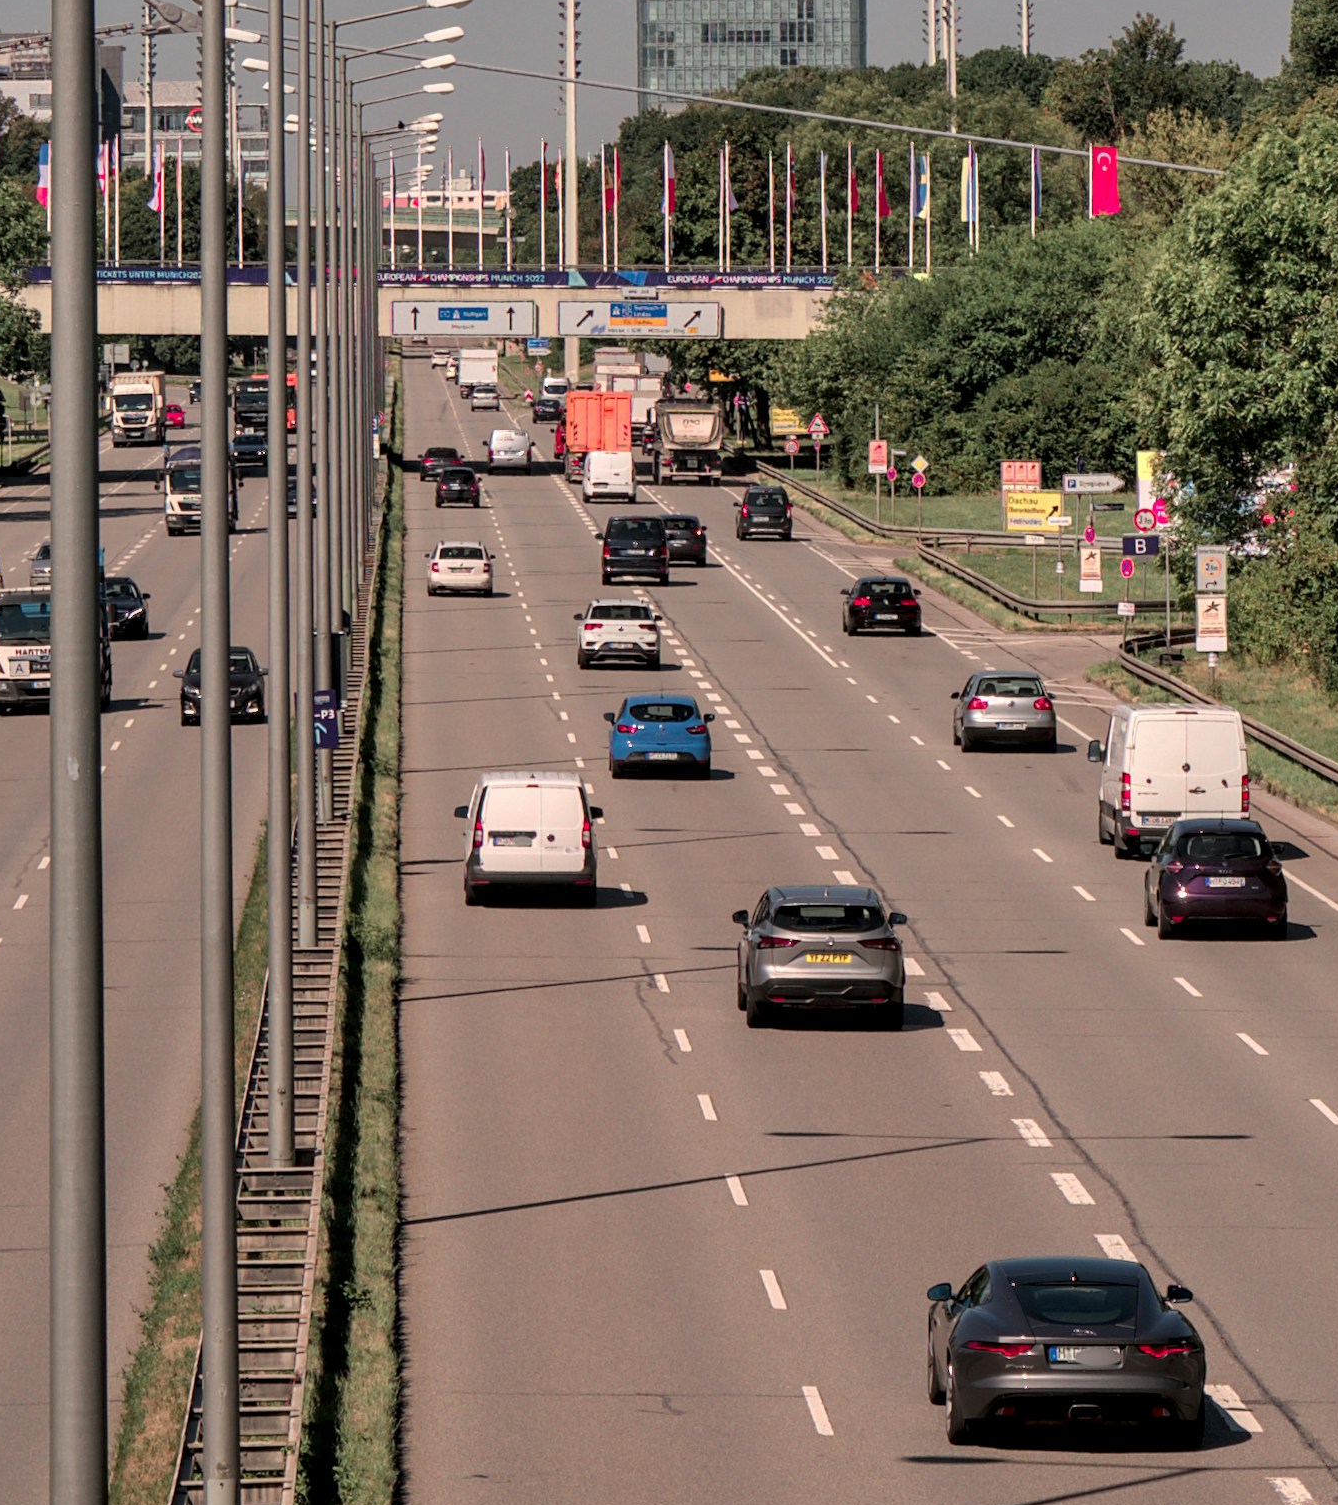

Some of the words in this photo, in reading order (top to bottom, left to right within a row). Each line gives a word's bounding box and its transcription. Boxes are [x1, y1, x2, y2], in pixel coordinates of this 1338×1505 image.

[185, 115, 202, 125] AW
[96, 270, 127, 278] TICKETS
[129, 270, 156, 279] UNTER
[377, 273, 417, 282] EUROPEAN
[430, 273, 489, 282] CHAMPIONSHIPS
[491, 274, 523, 282] MUNICH
[524, 274, 545, 283] 2022
[667, 275, 709, 283] EUROPEAN
[722, 275, 781, 284] CHAMPIONSHIPS
[783, 275, 815, 284] MUNICH
[1008, 496, 1039, 505] Dachau
[1135, 539, 1147, 554] B
[15, 648, 50, 656] HARTM
[15, 663, 24, 674] A
